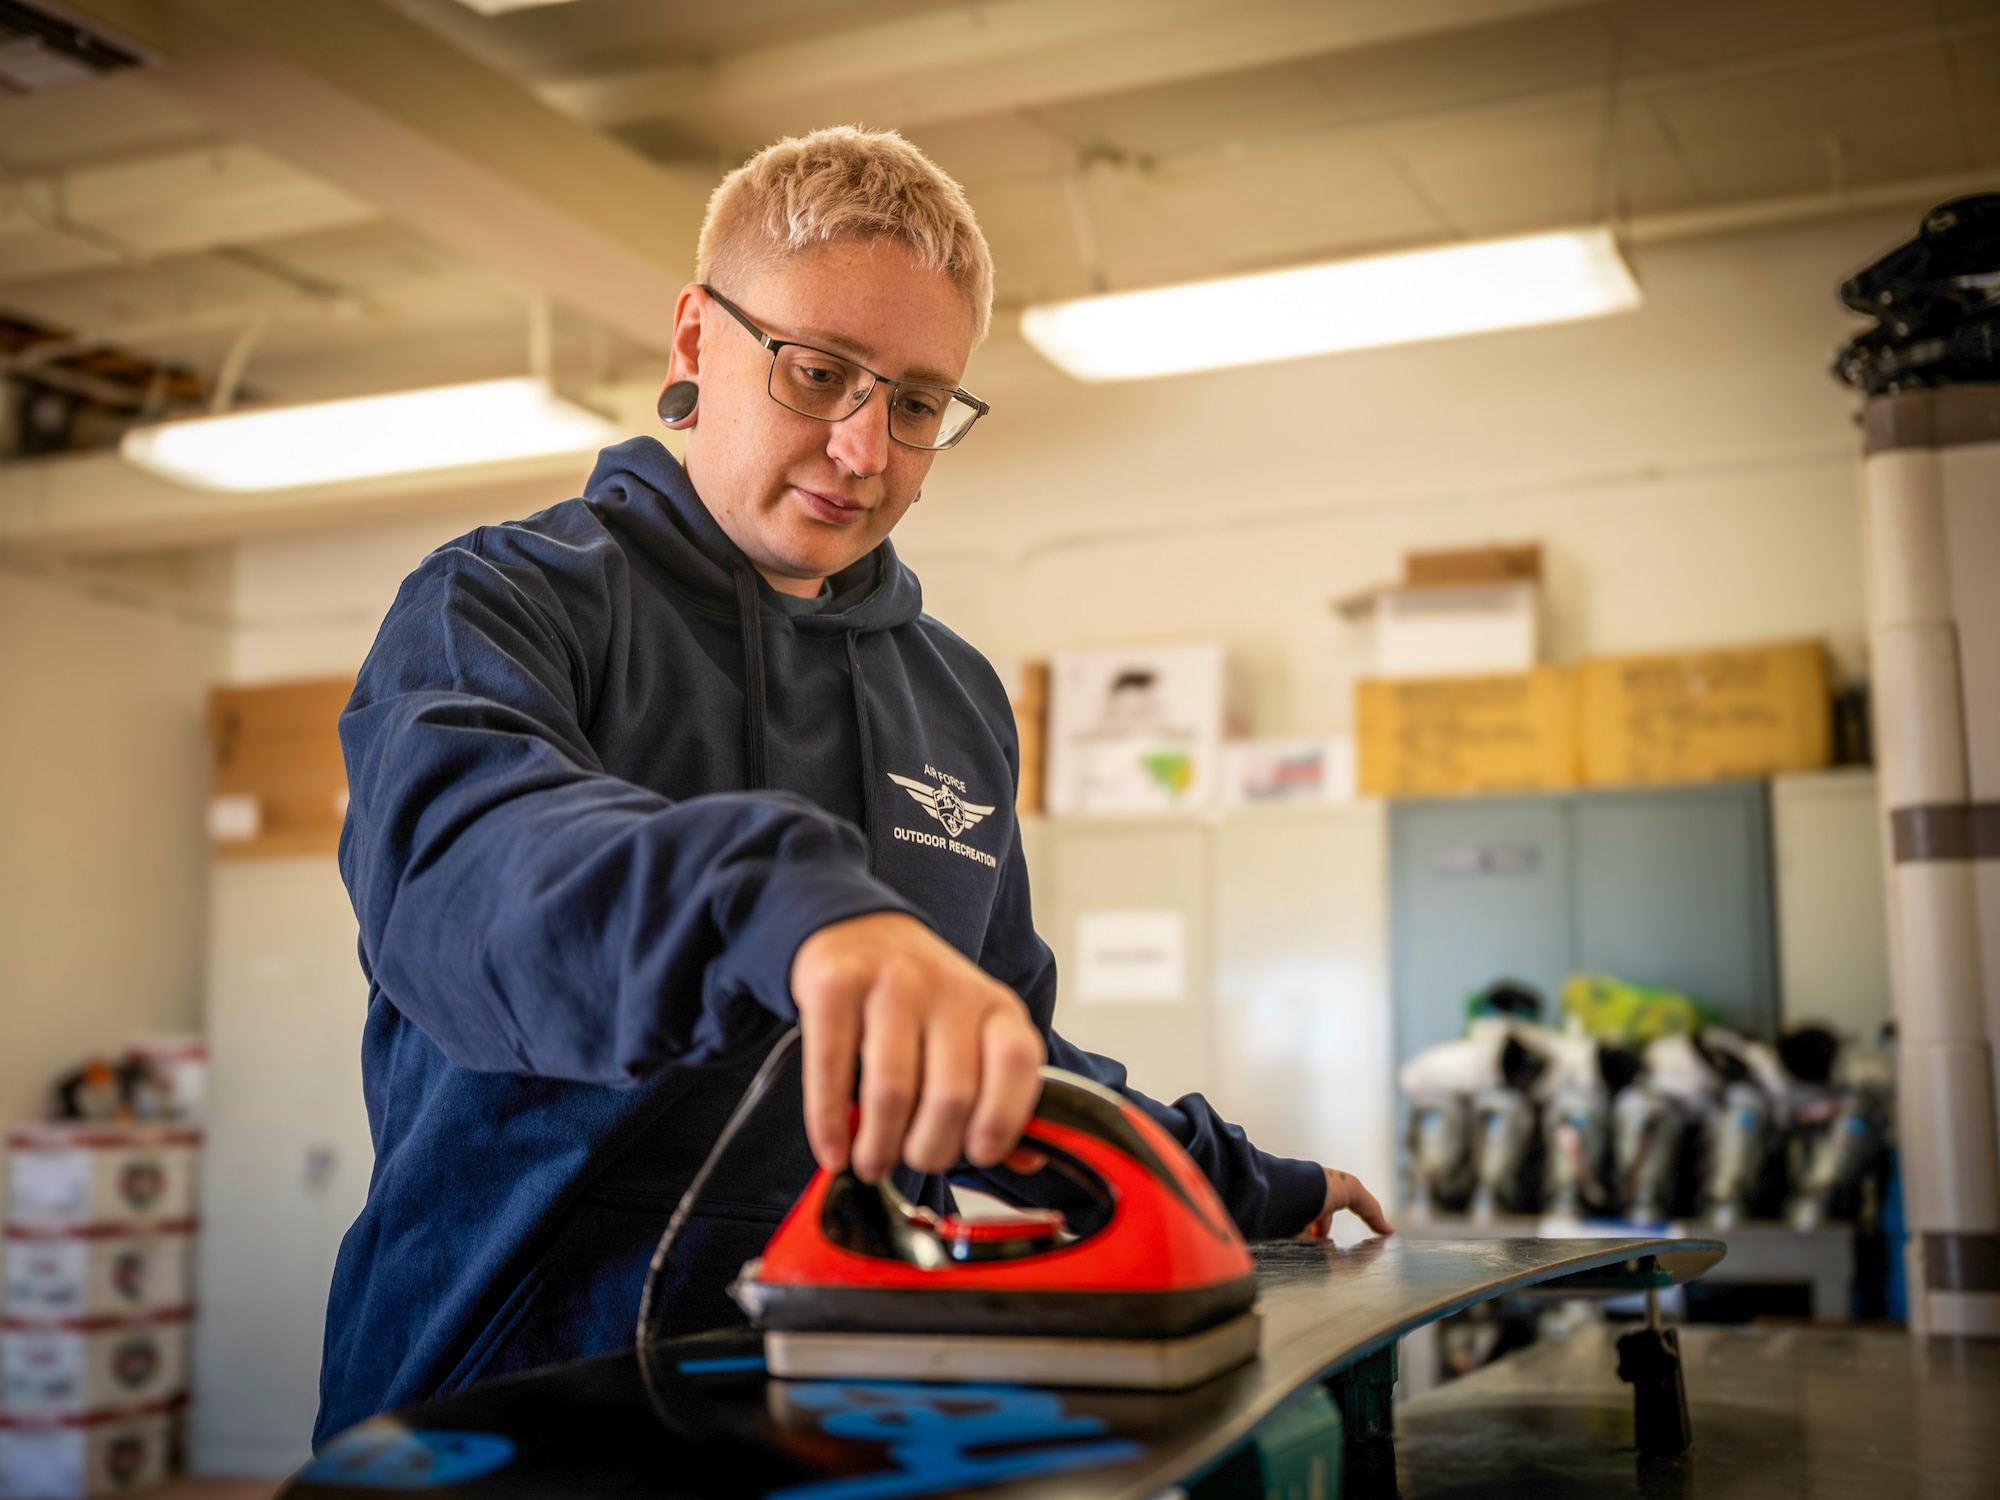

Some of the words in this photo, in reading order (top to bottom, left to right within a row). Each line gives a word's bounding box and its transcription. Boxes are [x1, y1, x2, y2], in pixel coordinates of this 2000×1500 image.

[924, 763, 937, 779] AIR
[938, 771, 966, 793] FORCE
[893, 826, 947, 849] OUTDOOR
[949, 839, 996, 868] RECREATION
